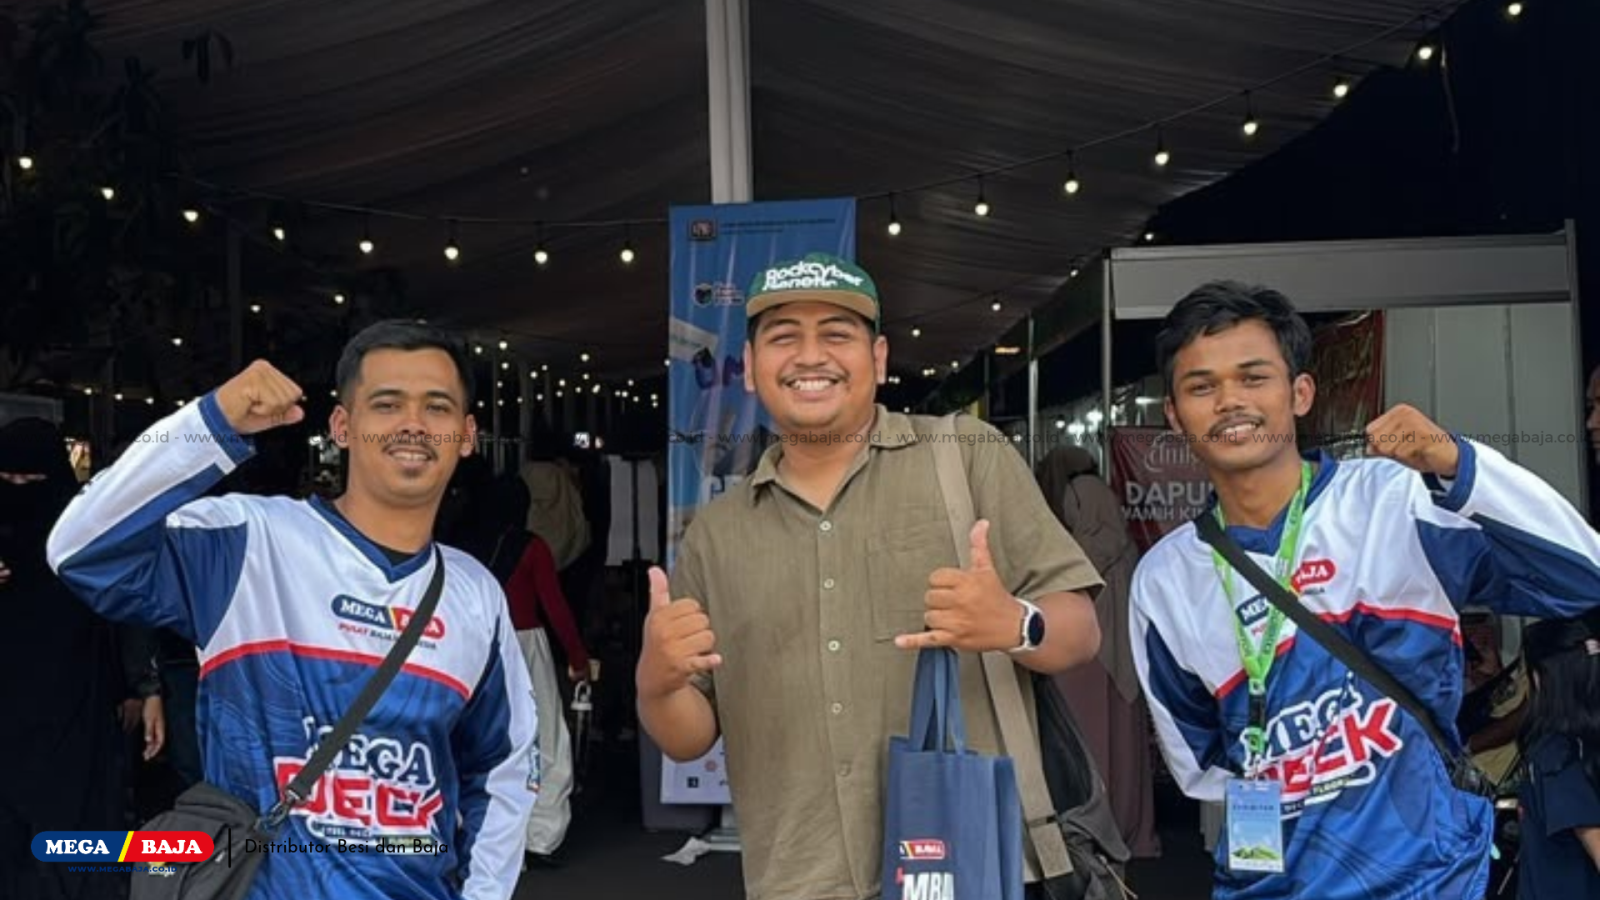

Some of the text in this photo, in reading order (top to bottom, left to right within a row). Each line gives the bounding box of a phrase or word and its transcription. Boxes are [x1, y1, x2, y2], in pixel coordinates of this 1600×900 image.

[1125, 481, 1214, 506] DAPU
[340, 599, 387, 624] MEGA
[302, 716, 435, 787] EGA
[1245, 698, 1402, 795] ECK
